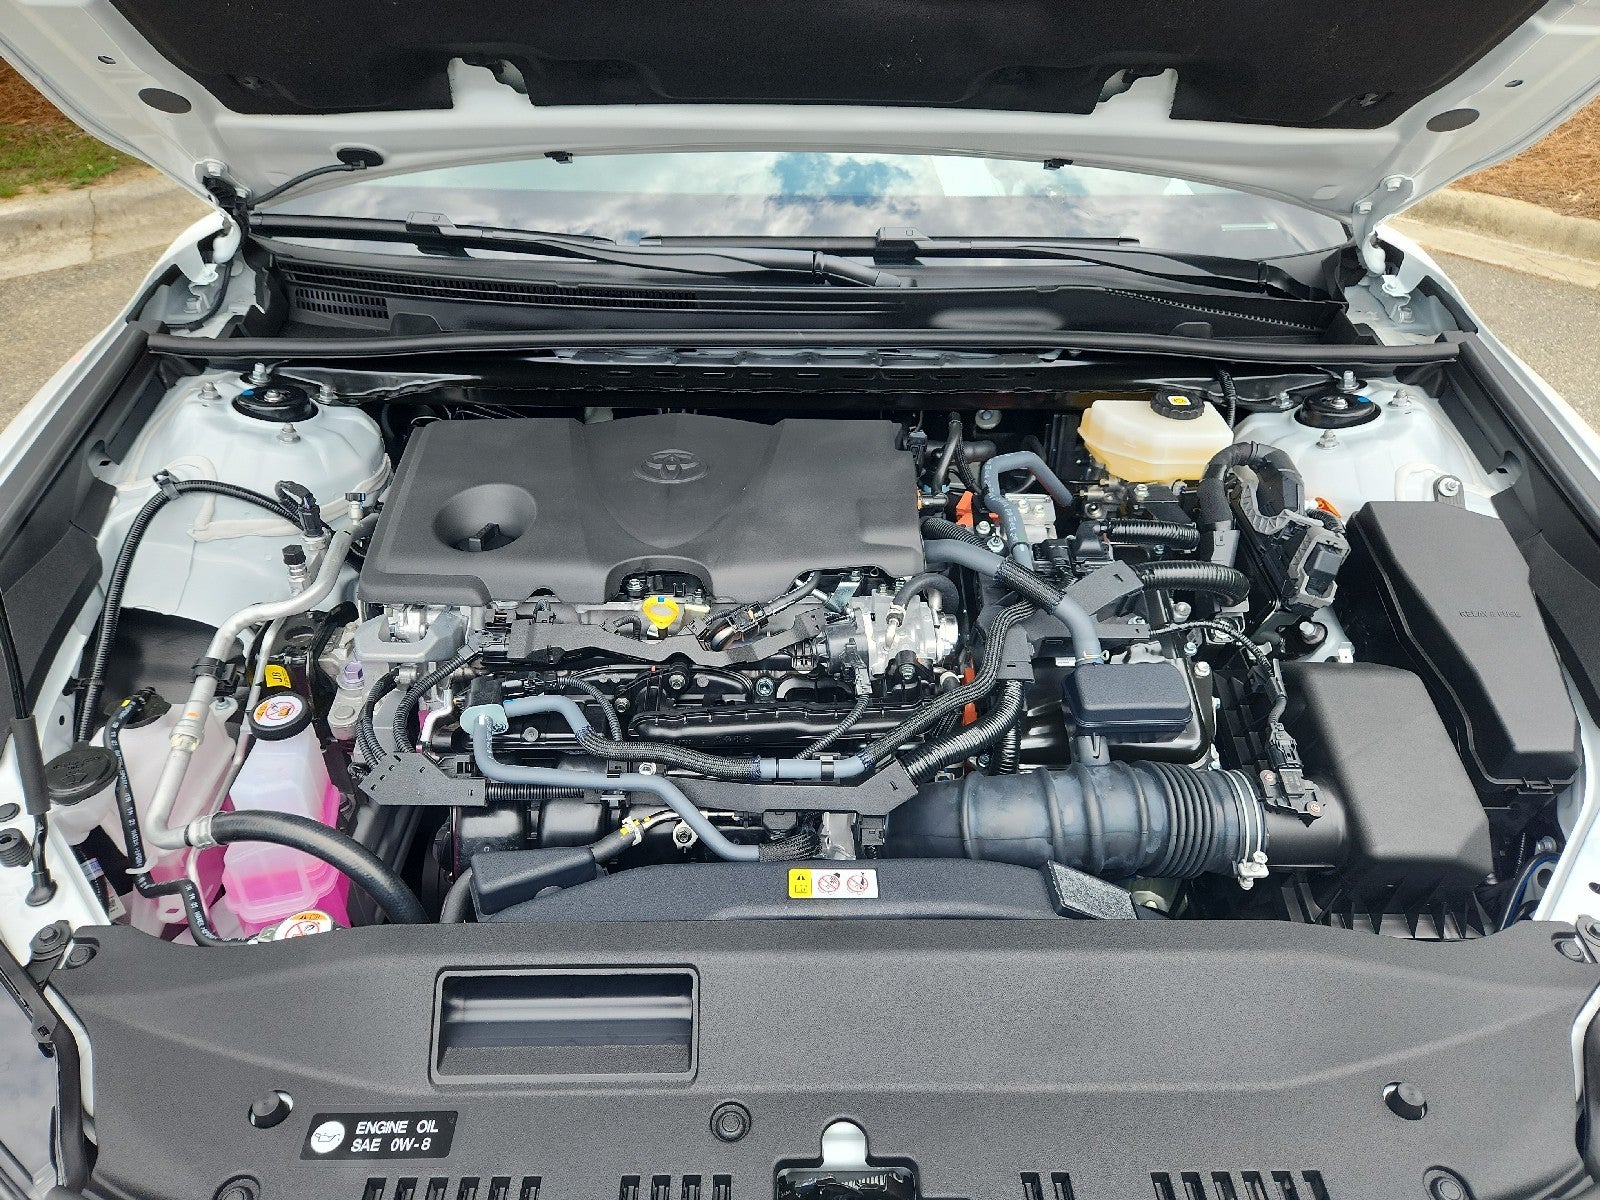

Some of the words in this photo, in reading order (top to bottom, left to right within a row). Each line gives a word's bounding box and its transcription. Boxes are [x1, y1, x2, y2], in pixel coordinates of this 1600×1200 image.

[1458, 610, 1488, 618] RELAY
[355, 1120, 408, 1135] ENGINE
[416, 1119, 439, 1134] OIL
[350, 1138, 382, 1152] SAE
[390, 1137, 432, 1151] 0W-8
